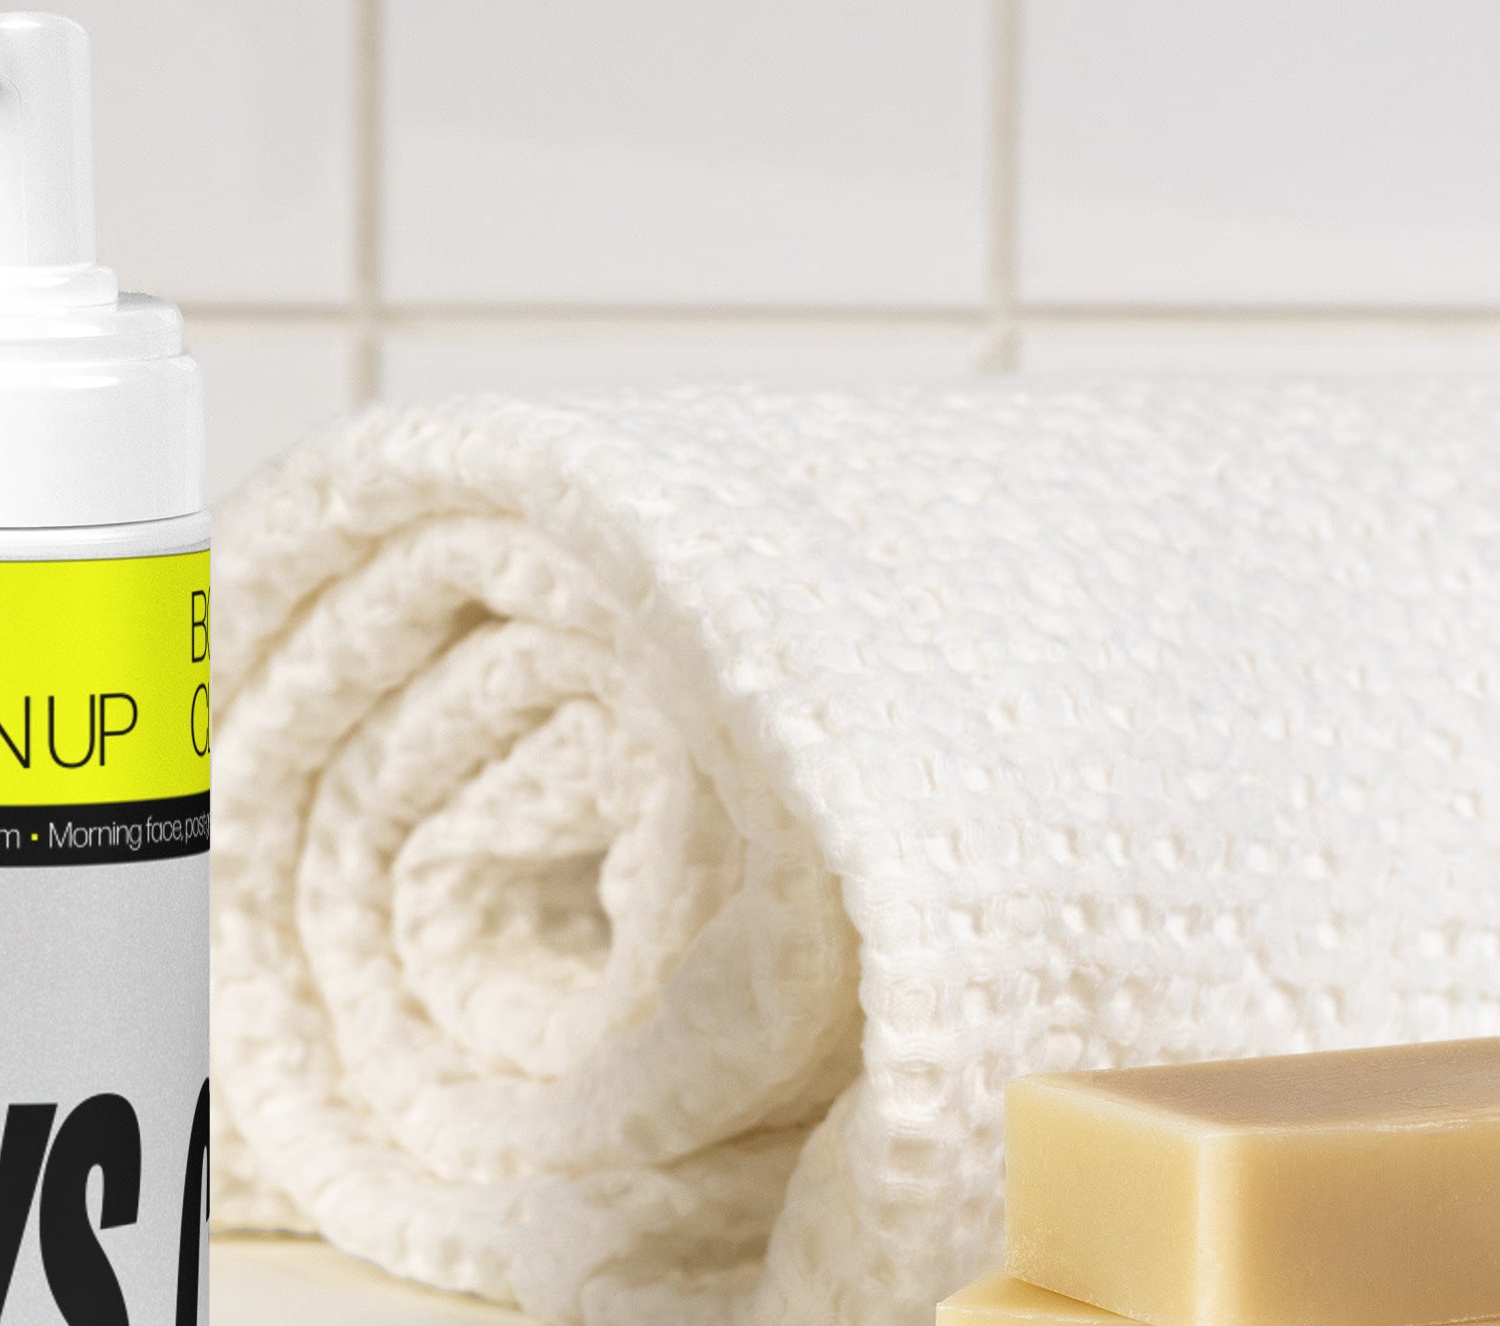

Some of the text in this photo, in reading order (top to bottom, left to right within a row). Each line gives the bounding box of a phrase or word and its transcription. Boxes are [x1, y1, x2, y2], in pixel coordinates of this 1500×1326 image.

[47, 692, 139, 769] UP
[48, 819, 143, 851] Morning
[145, 815, 184, 844] face,
